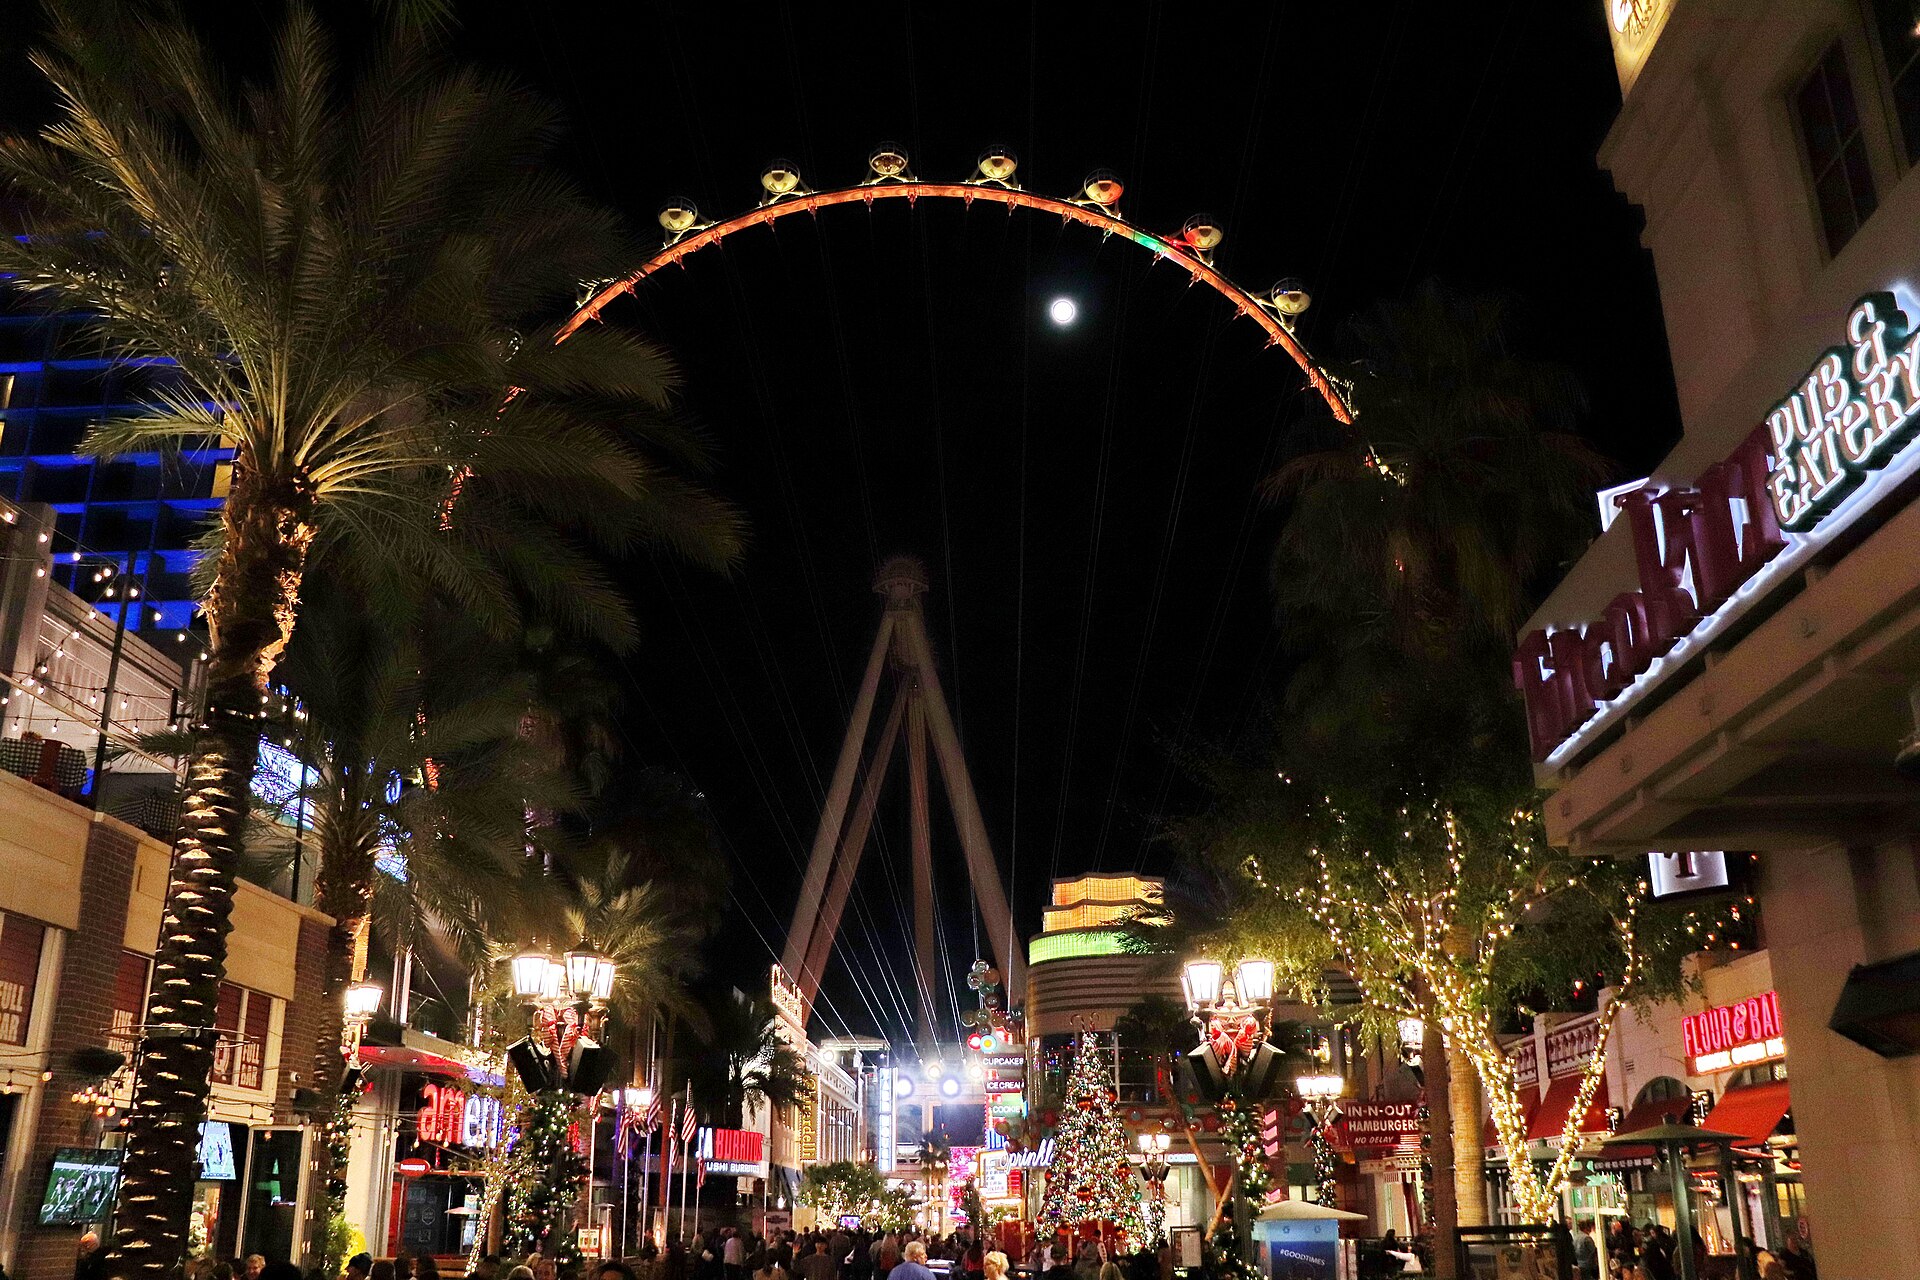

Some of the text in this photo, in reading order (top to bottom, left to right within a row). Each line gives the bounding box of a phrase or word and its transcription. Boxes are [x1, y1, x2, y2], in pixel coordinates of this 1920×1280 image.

[1766, 353, 1850, 470] PUB
[1682, 1006, 1734, 1058] FLOUR
[1732, 1002, 1748, 1041] &
[242, 1042, 260, 1065] FULL
[982, 1057, 1024, 1066] CUPCAKES
[239, 1063, 258, 1087] BAR
[986, 1081, 998, 1089] ICE
[1347, 1104, 1412, 1118] IN-N-OUT
[1348, 1119, 1420, 1132] HAMBURGERS
[1354, 1135, 1395, 1144] NO DELAY
[704, 1161, 729, 1172] USHI
[1279, 1247, 1326, 1266] #GOODTIMES
